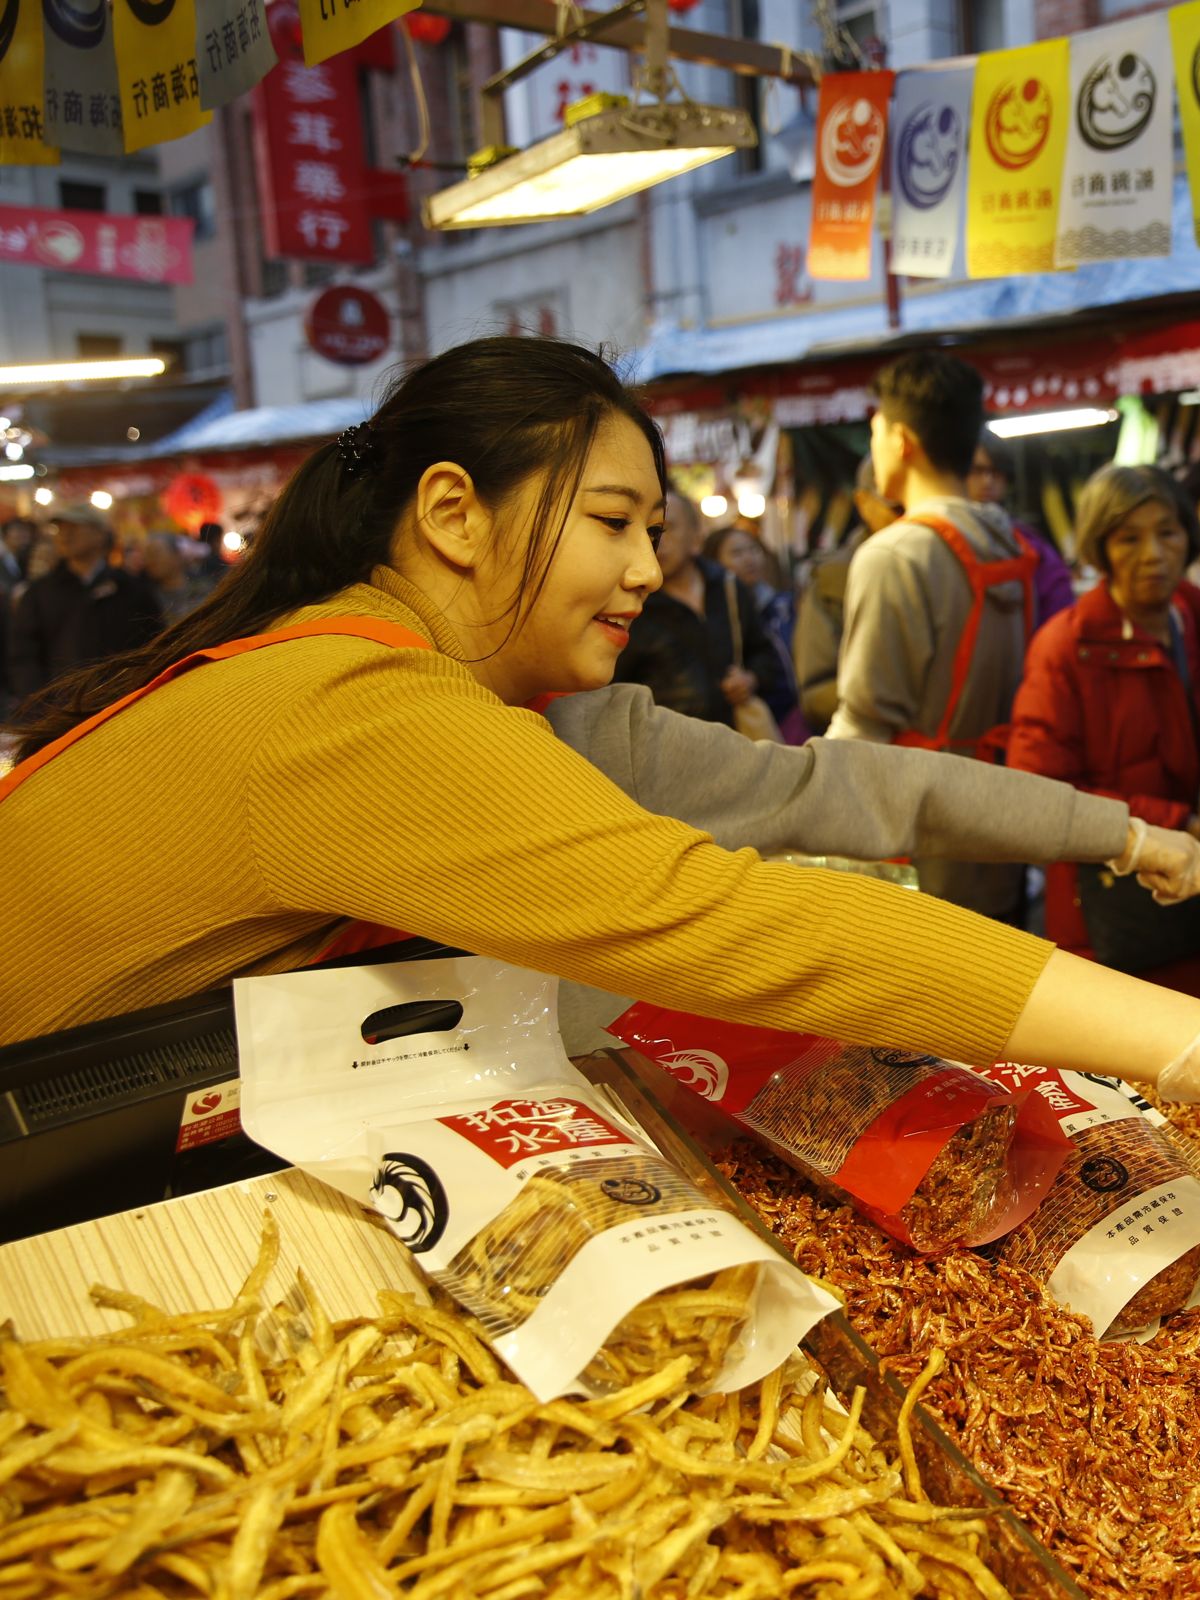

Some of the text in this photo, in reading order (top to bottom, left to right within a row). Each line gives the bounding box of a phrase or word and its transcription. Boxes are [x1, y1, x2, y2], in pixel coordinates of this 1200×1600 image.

[1105, 1191, 1178, 1240] 本產品需冷藏保存
[1128, 1206, 1184, 1246] 品質保證
